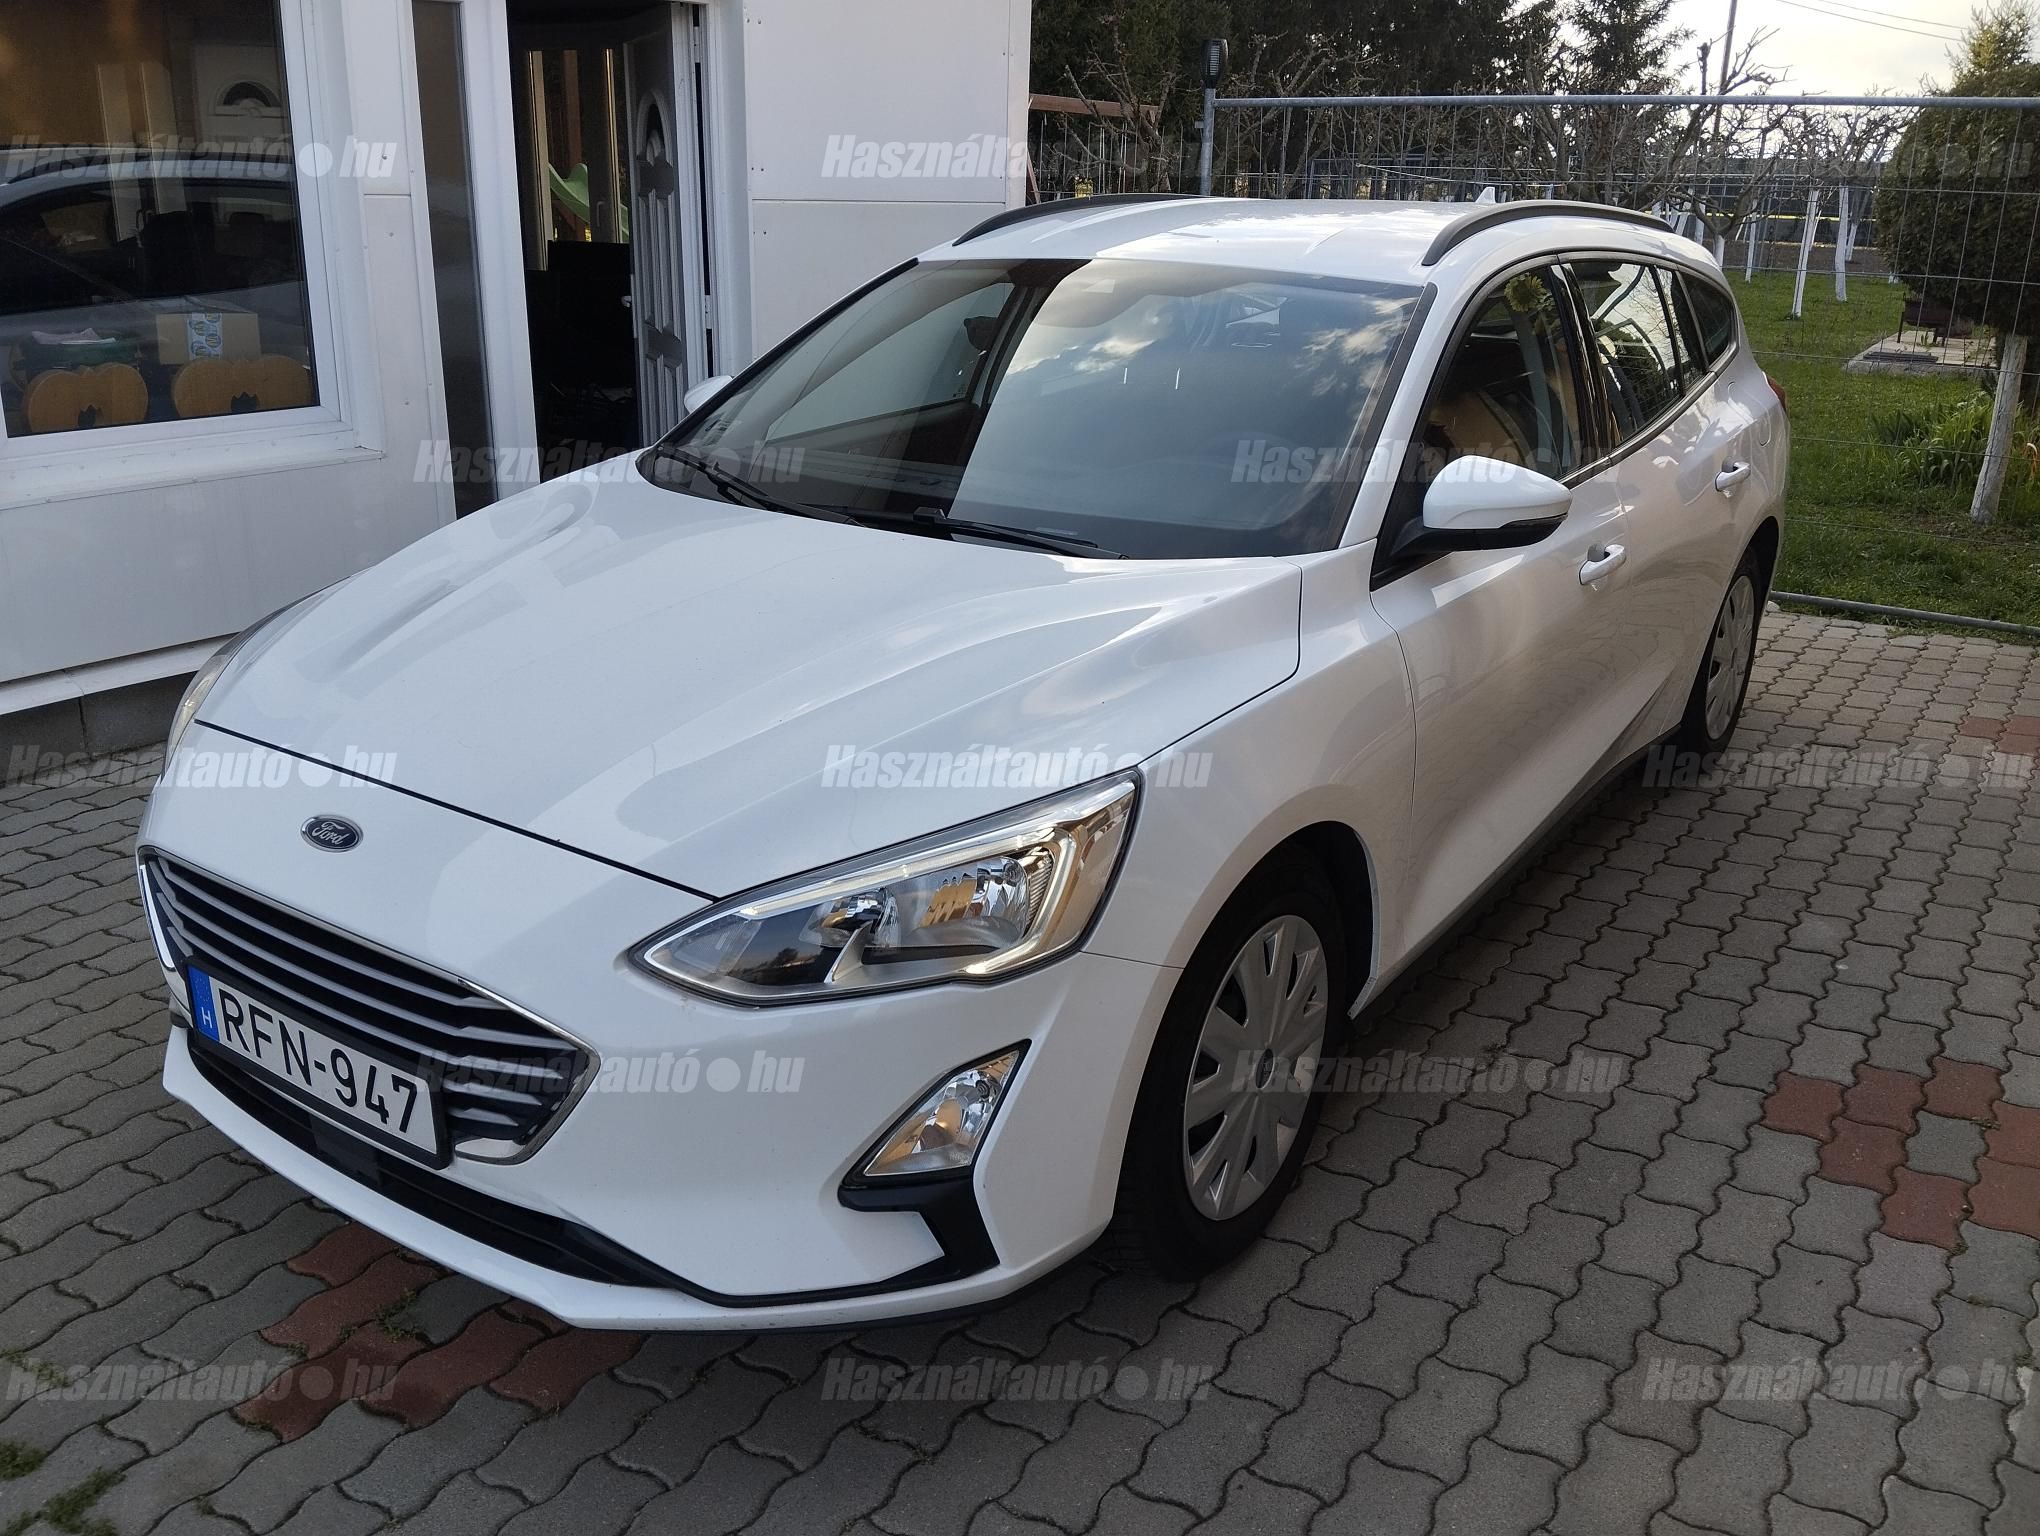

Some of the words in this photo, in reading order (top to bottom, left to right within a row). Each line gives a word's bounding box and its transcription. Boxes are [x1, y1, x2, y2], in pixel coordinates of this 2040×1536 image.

[311, 821, 350, 845] Ford
[201, 1007, 213, 1029] H
[219, 988, 417, 1133] RFN-947
